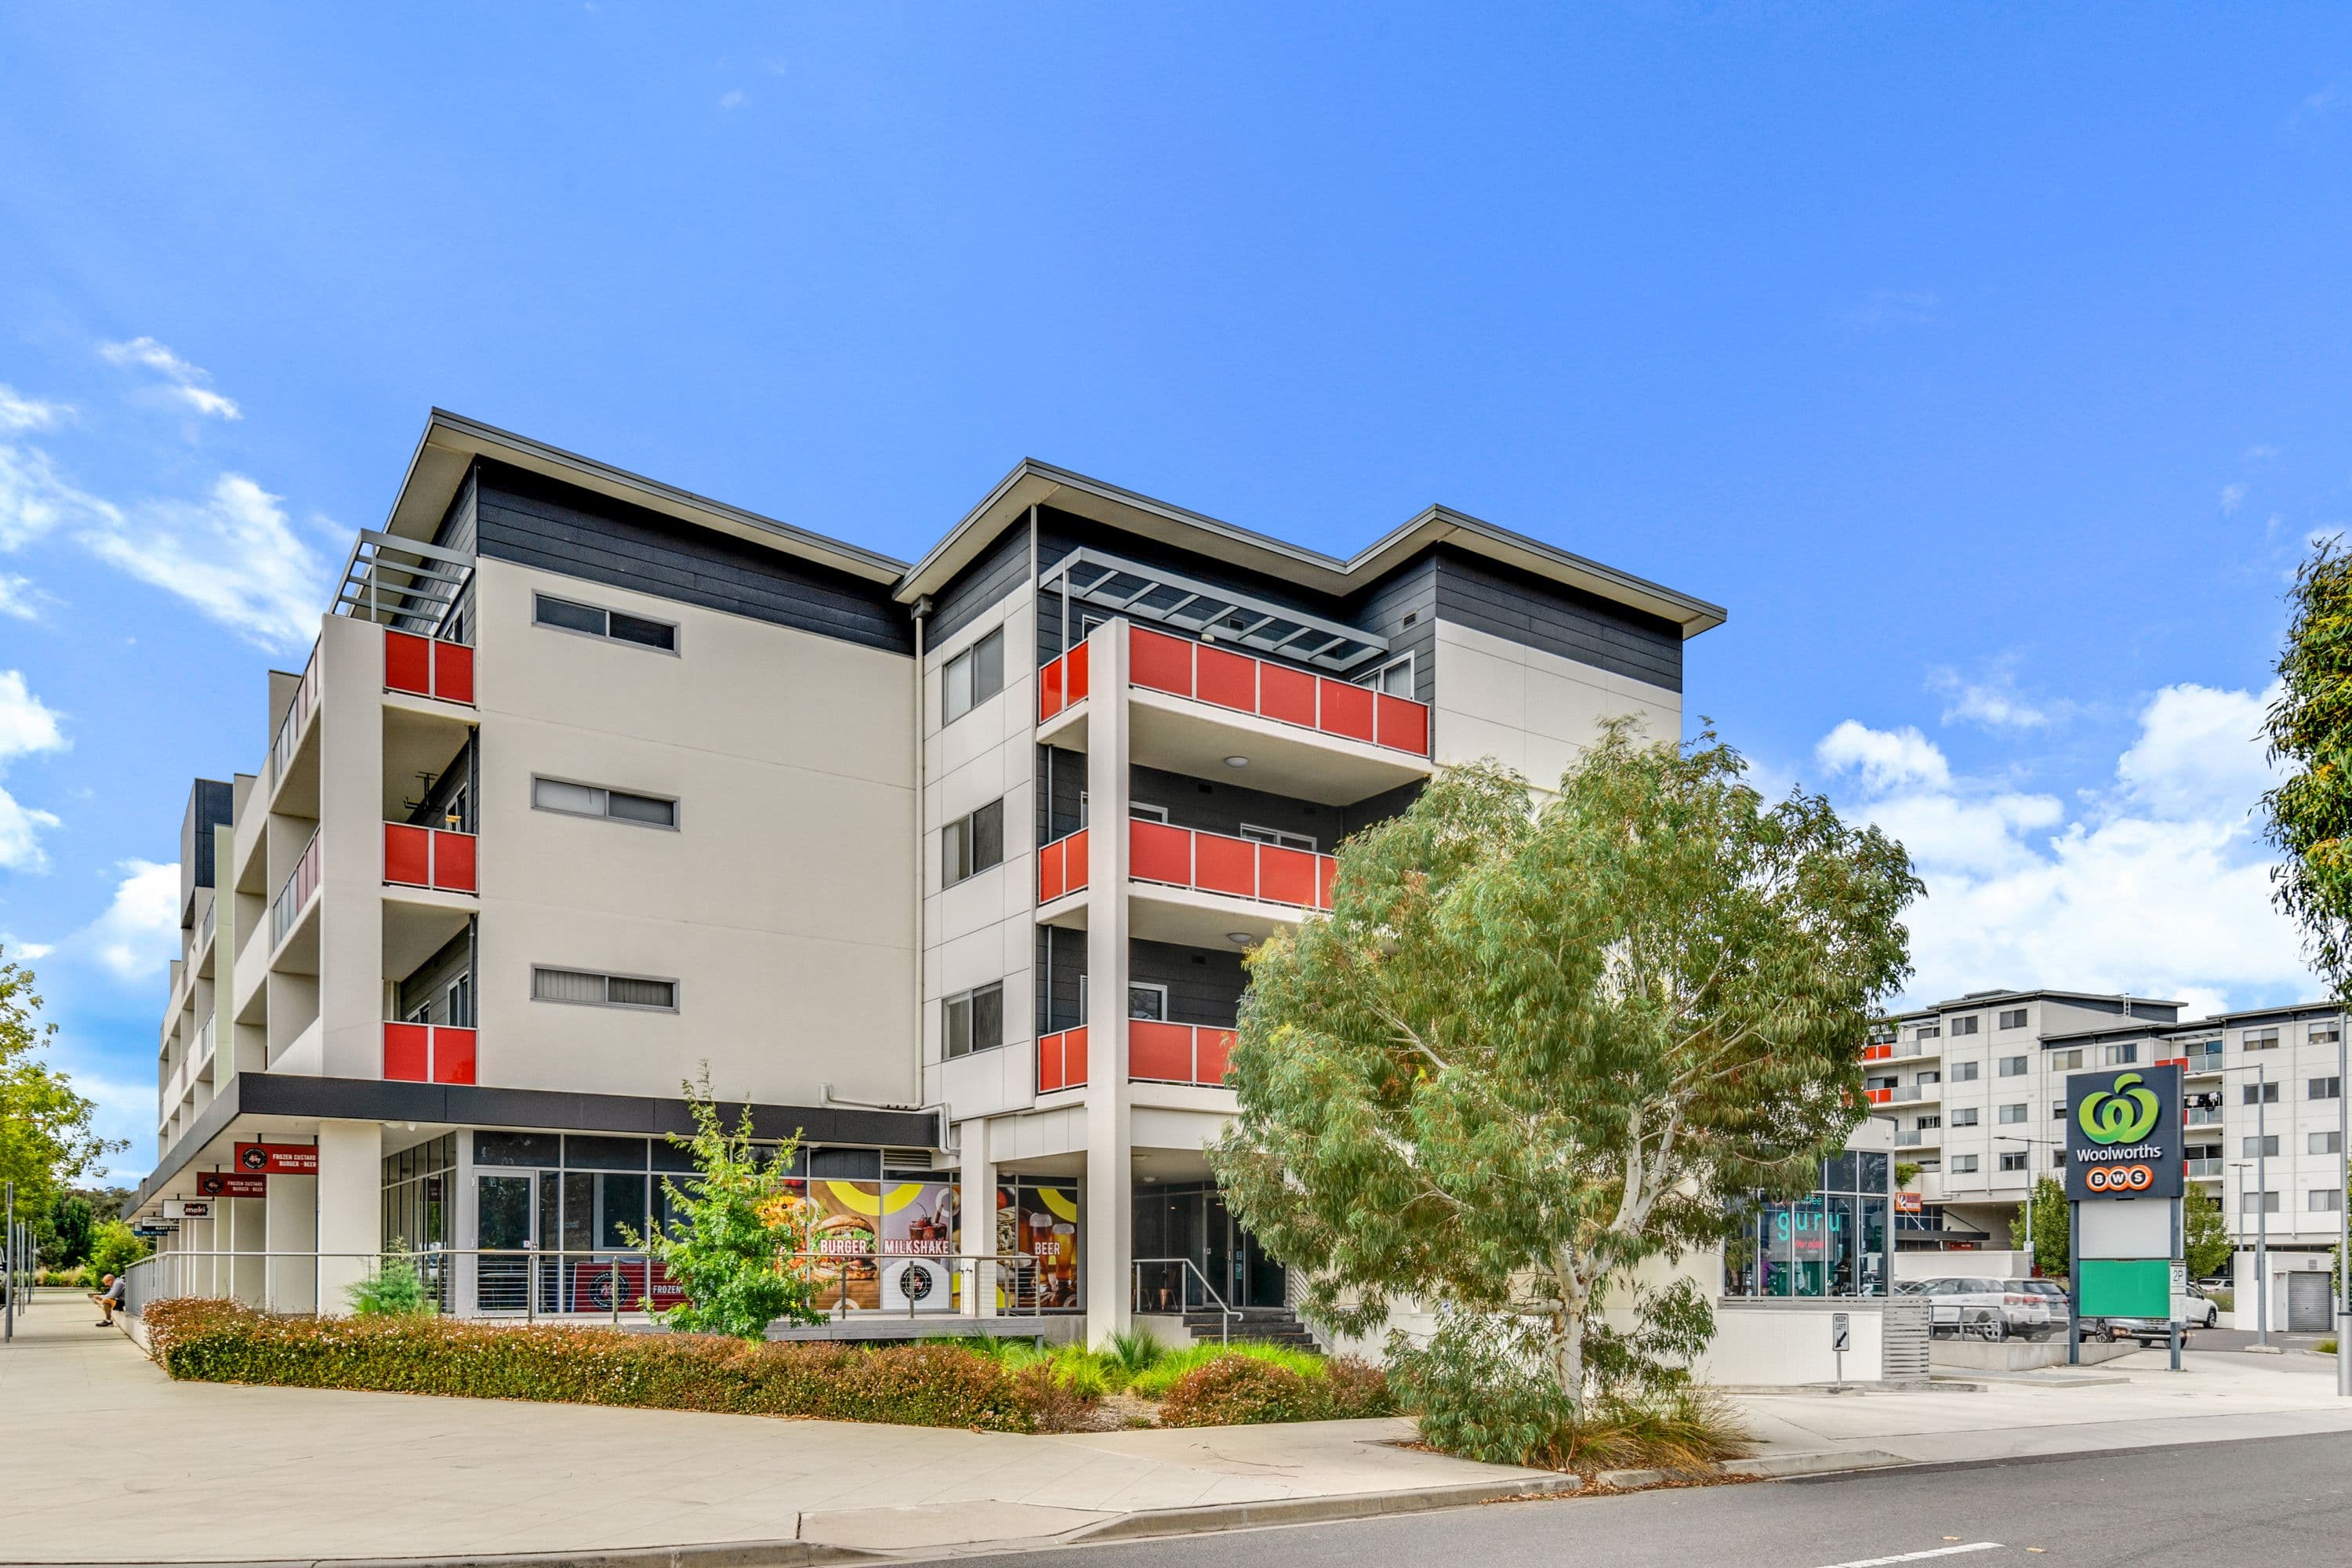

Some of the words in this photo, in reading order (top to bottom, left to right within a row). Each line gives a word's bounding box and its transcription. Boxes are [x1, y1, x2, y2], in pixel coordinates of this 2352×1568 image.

[2076, 1144, 2162, 1162] Woolworths
[2094, 1172, 2143, 1185] BWS
[1777, 1212, 1840, 1241] guru
[820, 1240, 866, 1254] BURGER
[884, 1240, 949, 1254] MILKSHAKE
[1035, 1241, 1061, 1255] BEER
[2173, 1269, 2183, 1282] 2P
[653, 1285, 681, 1294] FROZEN
